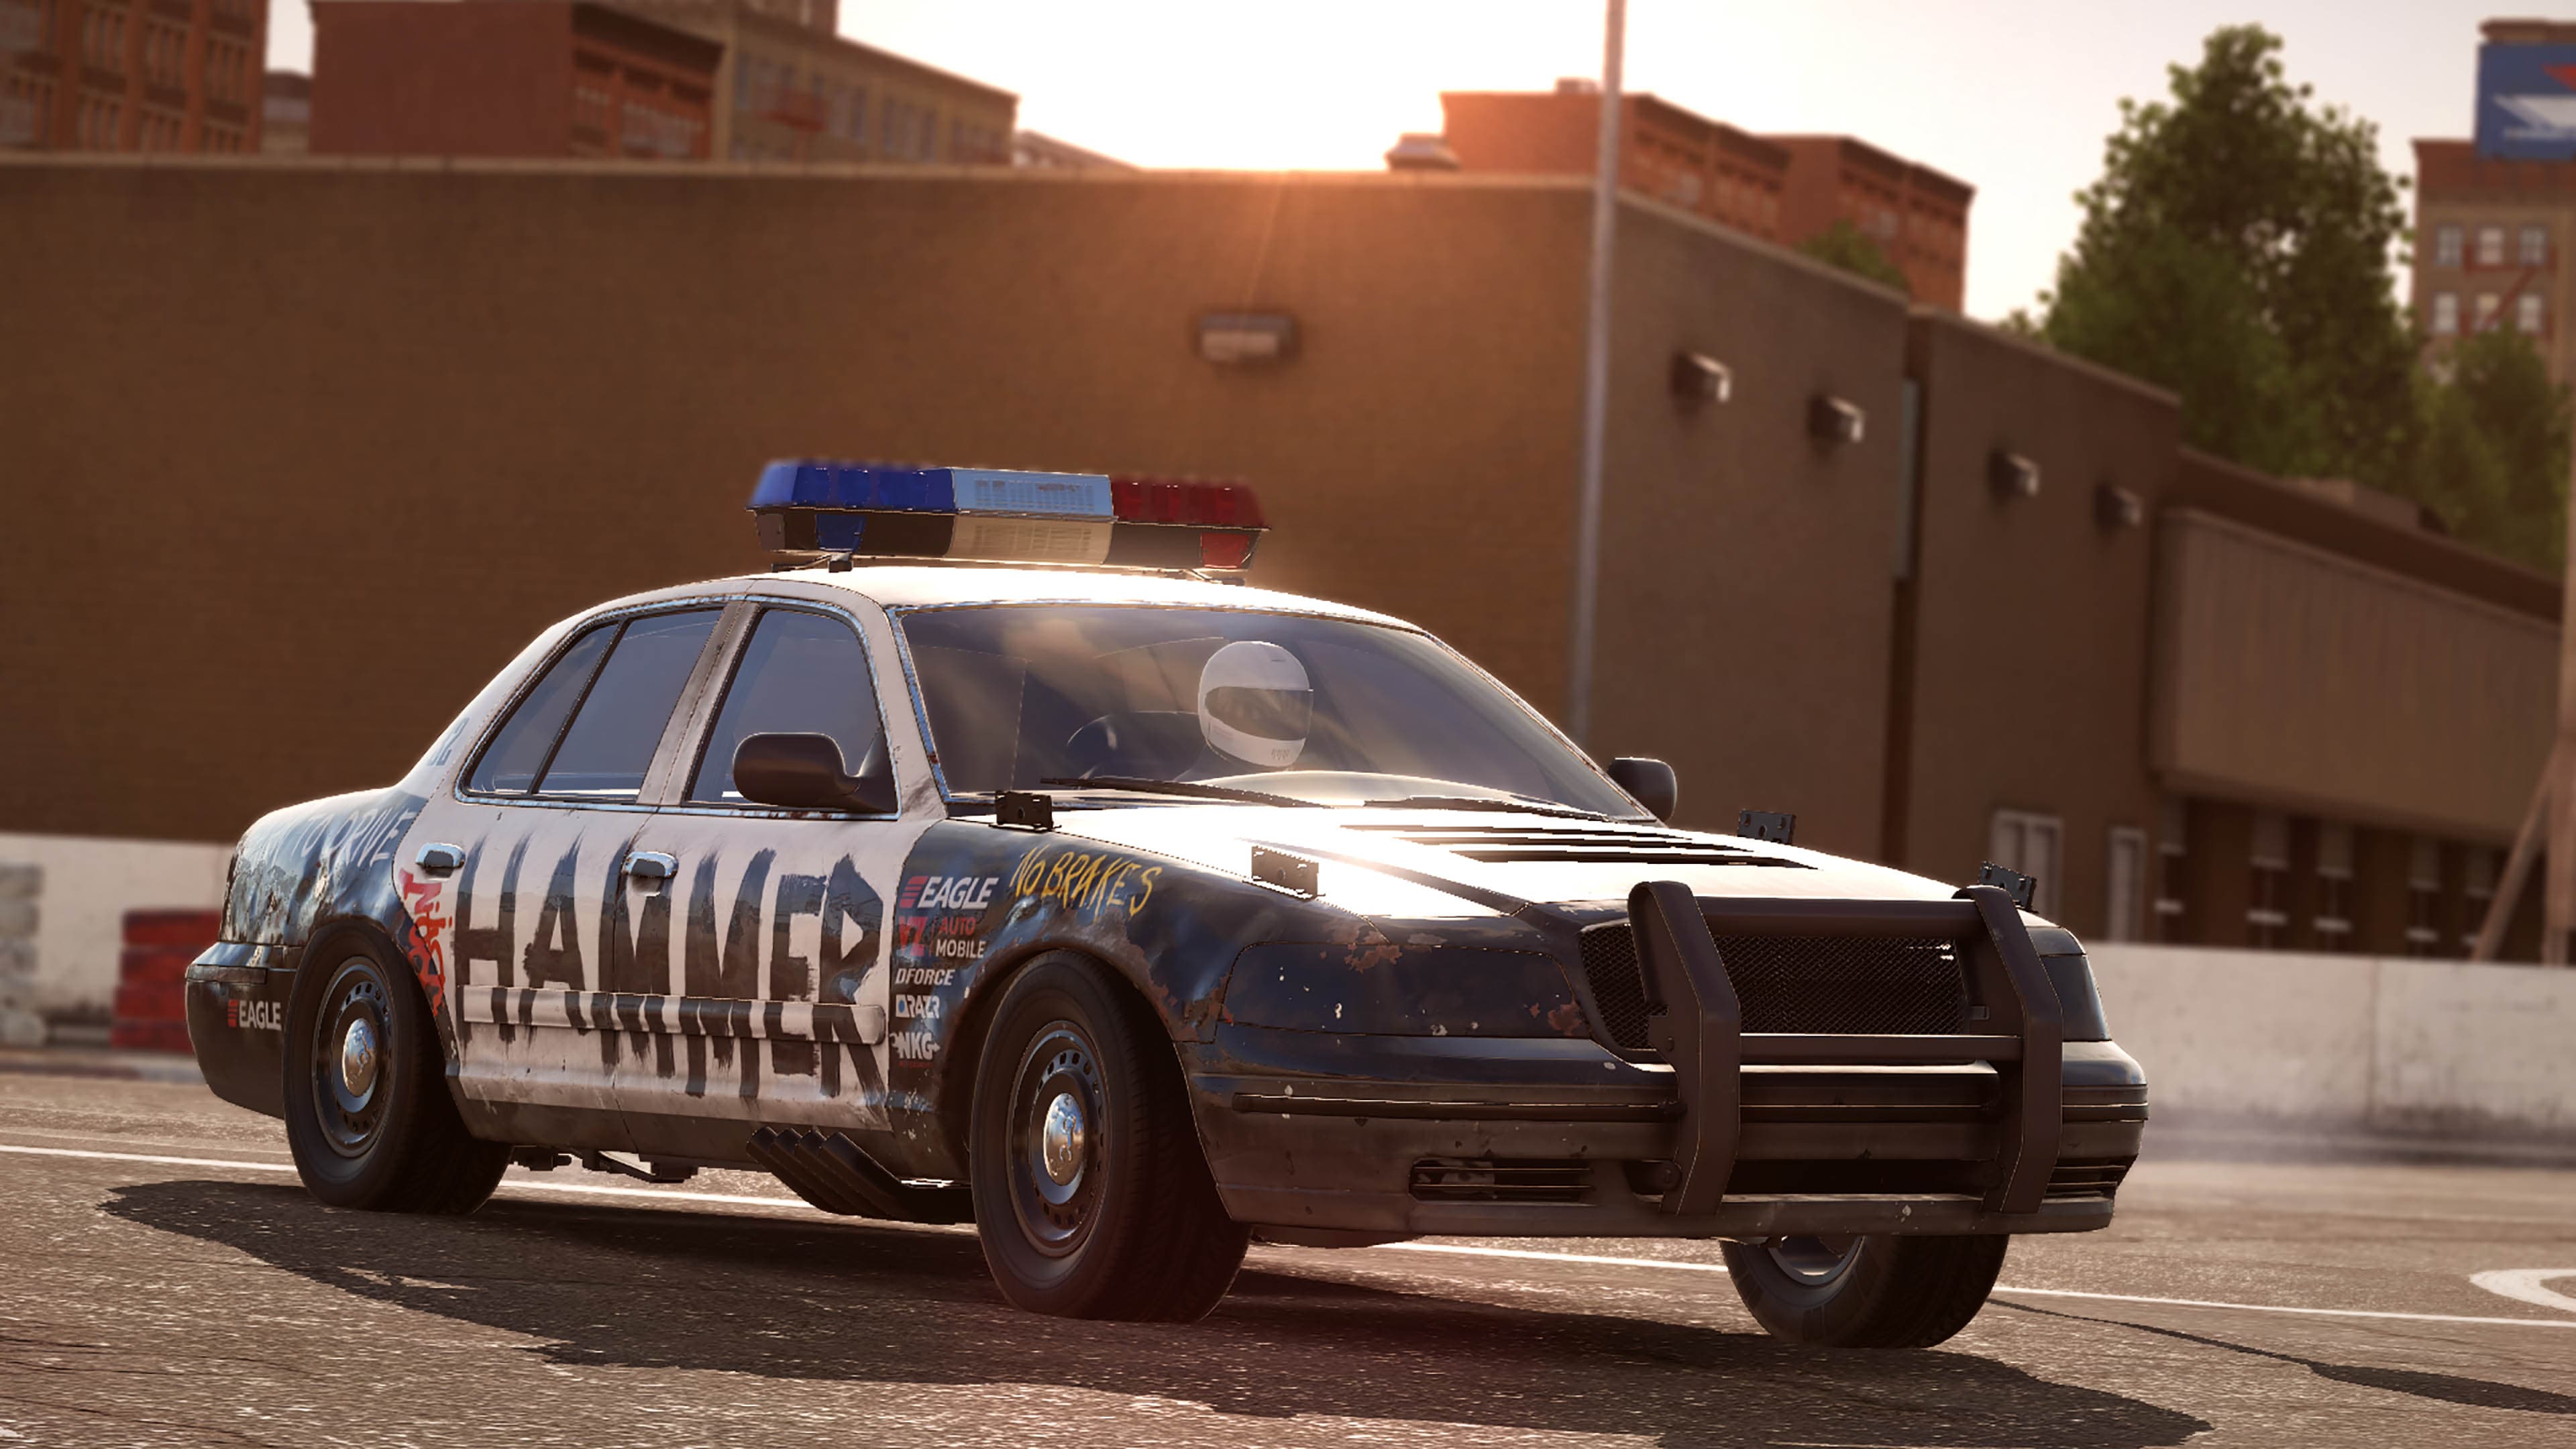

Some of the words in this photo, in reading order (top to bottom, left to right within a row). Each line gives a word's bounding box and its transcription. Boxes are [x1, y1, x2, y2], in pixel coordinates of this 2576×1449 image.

[329, 806, 418, 869] DRIVE
[917, 876, 1000, 910] EAGLE
[1040, 851, 1163, 923] BRAKES
[939, 916, 977, 936] AUTO
[936, 939, 987, 959] MOBILE
[453, 828, 890, 1119] HAMMER
[895, 968, 956, 985] DFORCE
[239, 1000, 282, 1031] EAGLE
[898, 1031, 934, 1060] NKG
